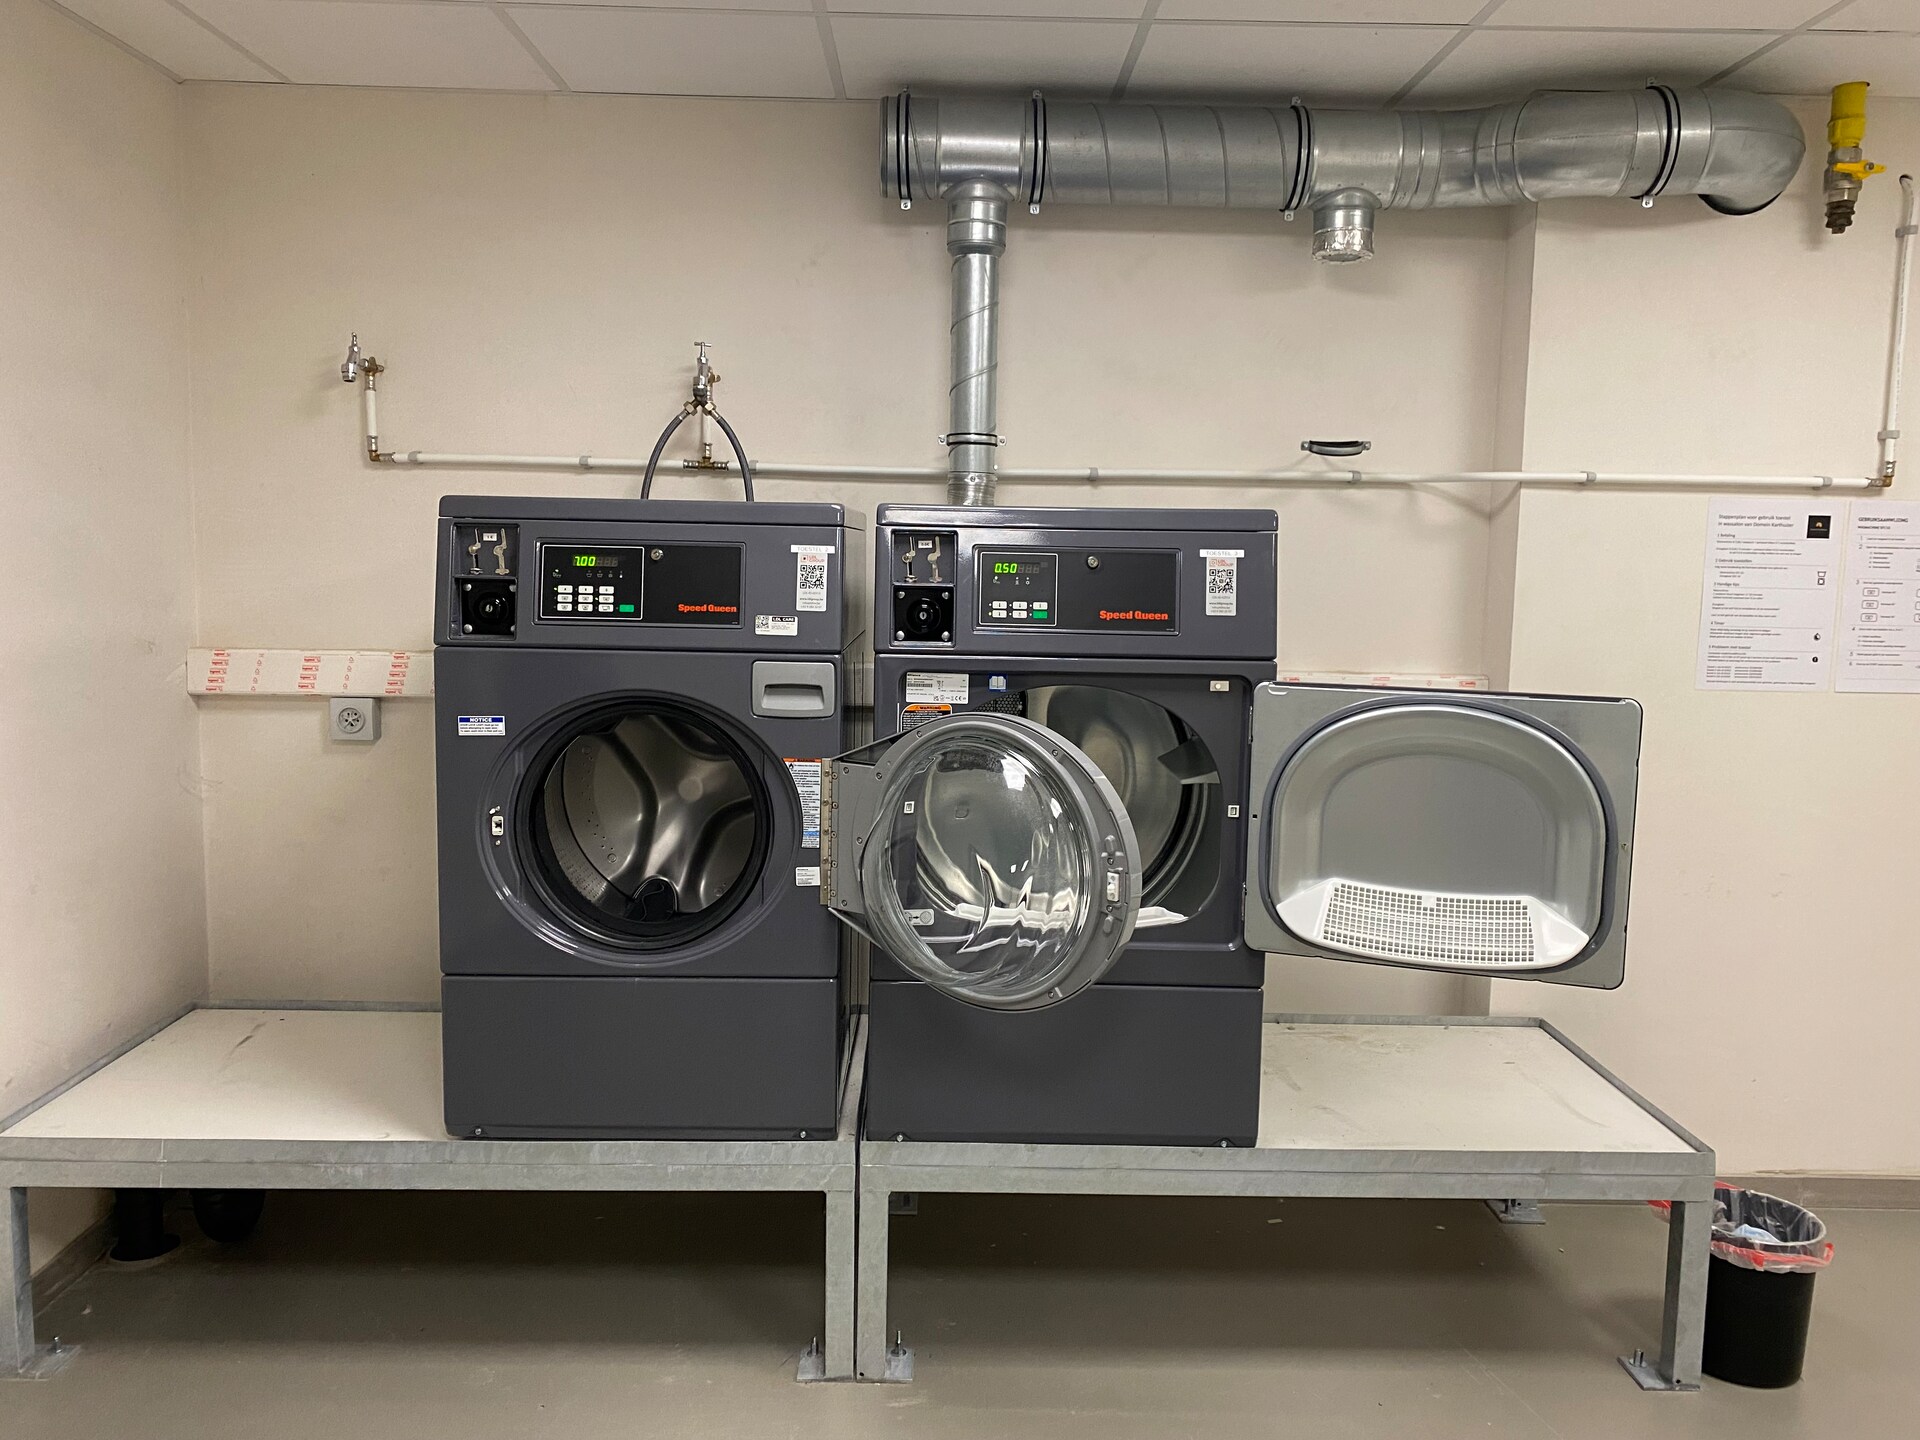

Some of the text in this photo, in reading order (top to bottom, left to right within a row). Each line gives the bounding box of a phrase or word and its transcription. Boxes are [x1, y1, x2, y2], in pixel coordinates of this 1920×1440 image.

[678, 604, 707, 613] Speed
[1099, 610, 1169, 620] Speed Queen
